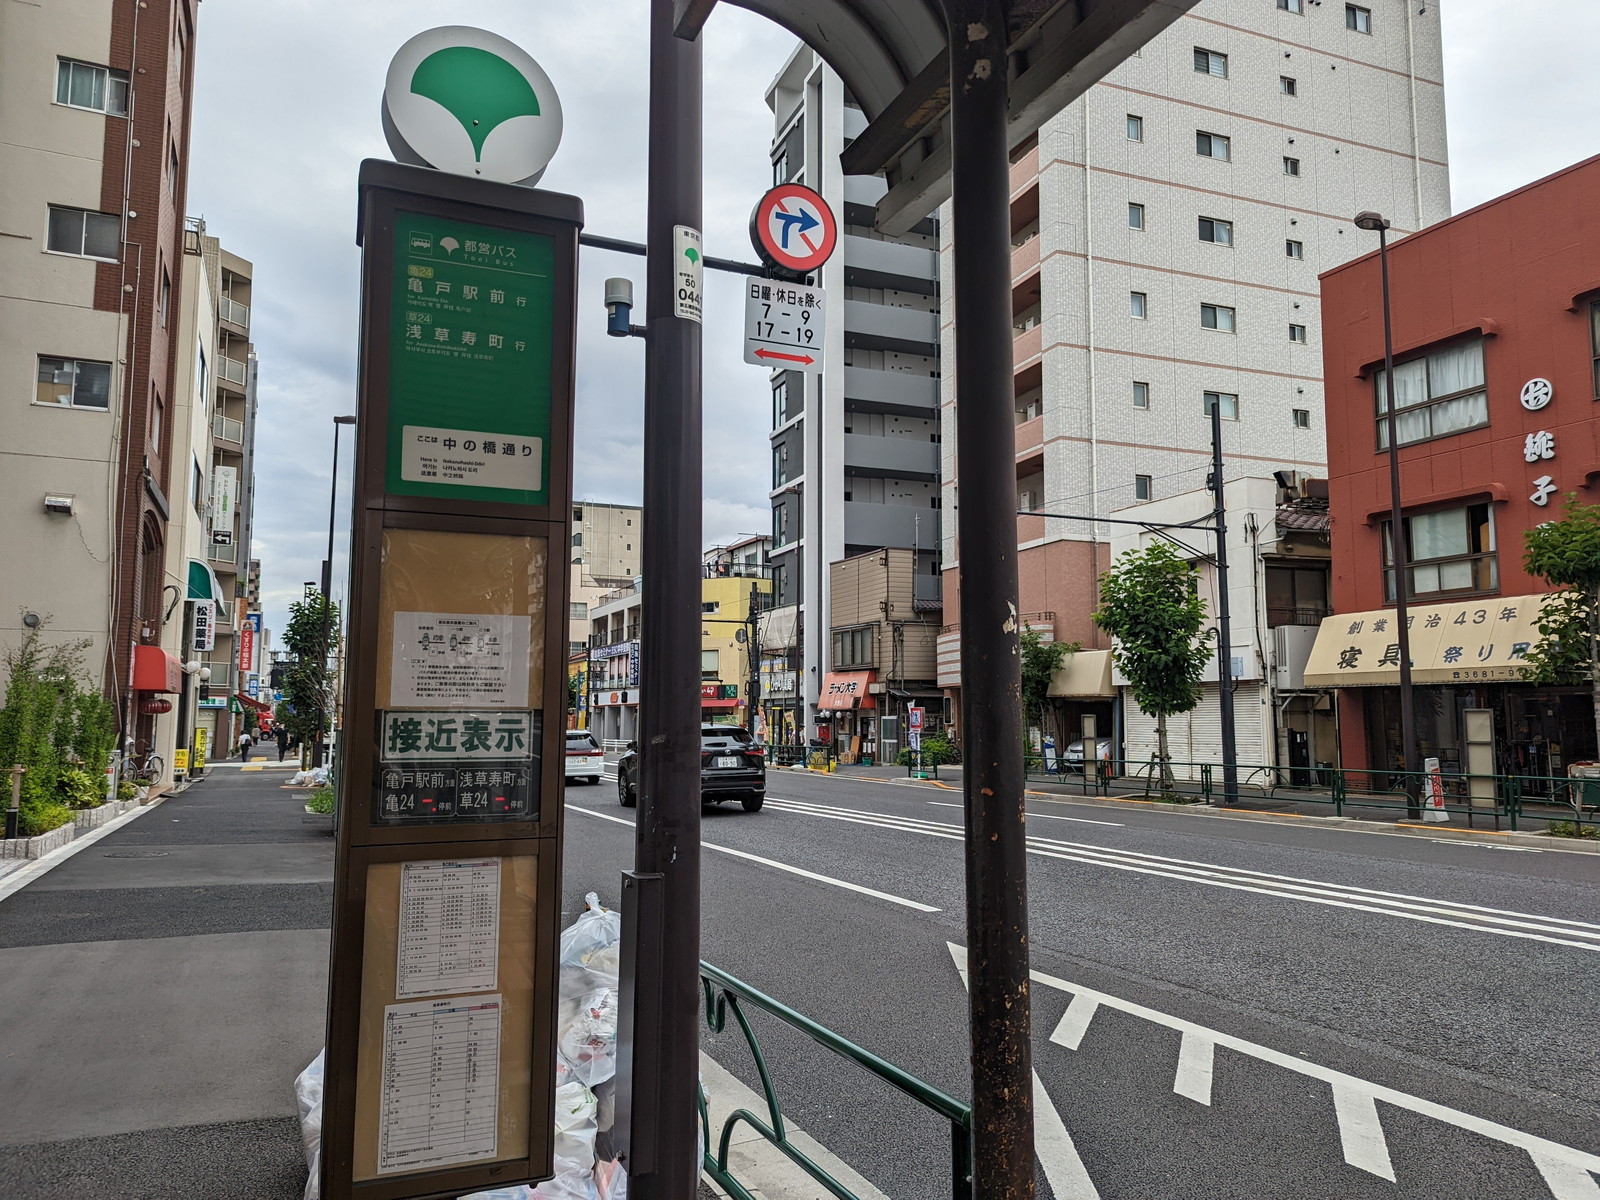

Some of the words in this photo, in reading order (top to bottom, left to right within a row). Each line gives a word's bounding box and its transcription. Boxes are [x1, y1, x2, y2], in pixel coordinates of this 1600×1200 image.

[464, 240, 517, 258] 都営バス
[408, 278, 505, 304] 亀戸駅前
[516, 297, 527, 307] 行
[685, 279, 696, 288] 50
[751, 284, 822, 310] 日曜・休日を除く
[406, 324, 504, 349] 浅草寿町
[515, 341, 526, 352] 行
[417, 435, 438, 443] ここは
[443, 438, 532, 456] 中の橋通り
[194, 606, 208, 650] 松田薬局
[1337, 644, 1400, 670] 寝具
[1443, 641, 1557, 664] 祭り用
[388, 718, 526, 753] 接近表示
[385, 794, 415, 812] 亀24
[460, 792, 488, 810] 草24
